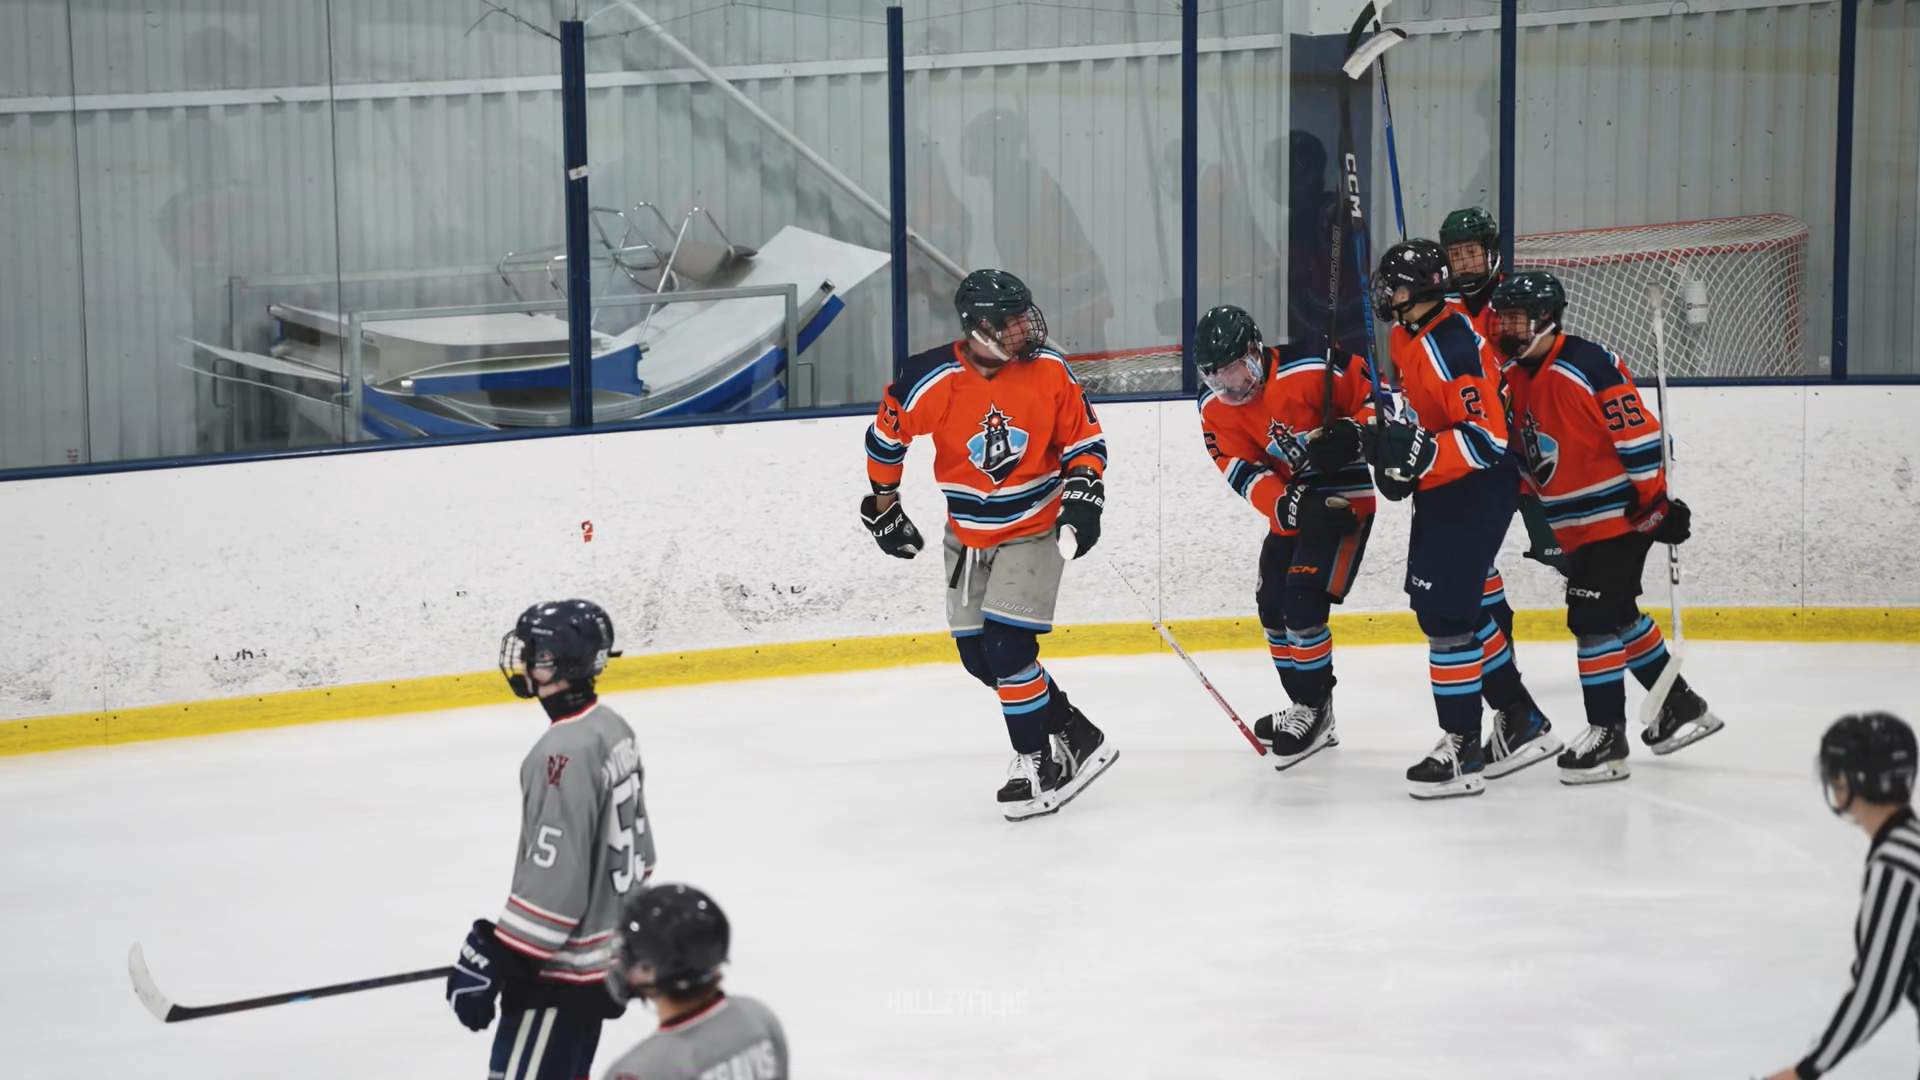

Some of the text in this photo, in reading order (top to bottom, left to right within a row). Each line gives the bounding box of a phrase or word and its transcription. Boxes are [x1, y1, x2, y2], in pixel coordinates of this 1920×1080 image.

[1344, 152, 1362, 218] CCM
[1602, 393, 1647, 432] 55
[1406, 424, 1426, 467] UER
[1061, 490, 1105, 509] BAUE
[1568, 587, 1601, 600] CCM
